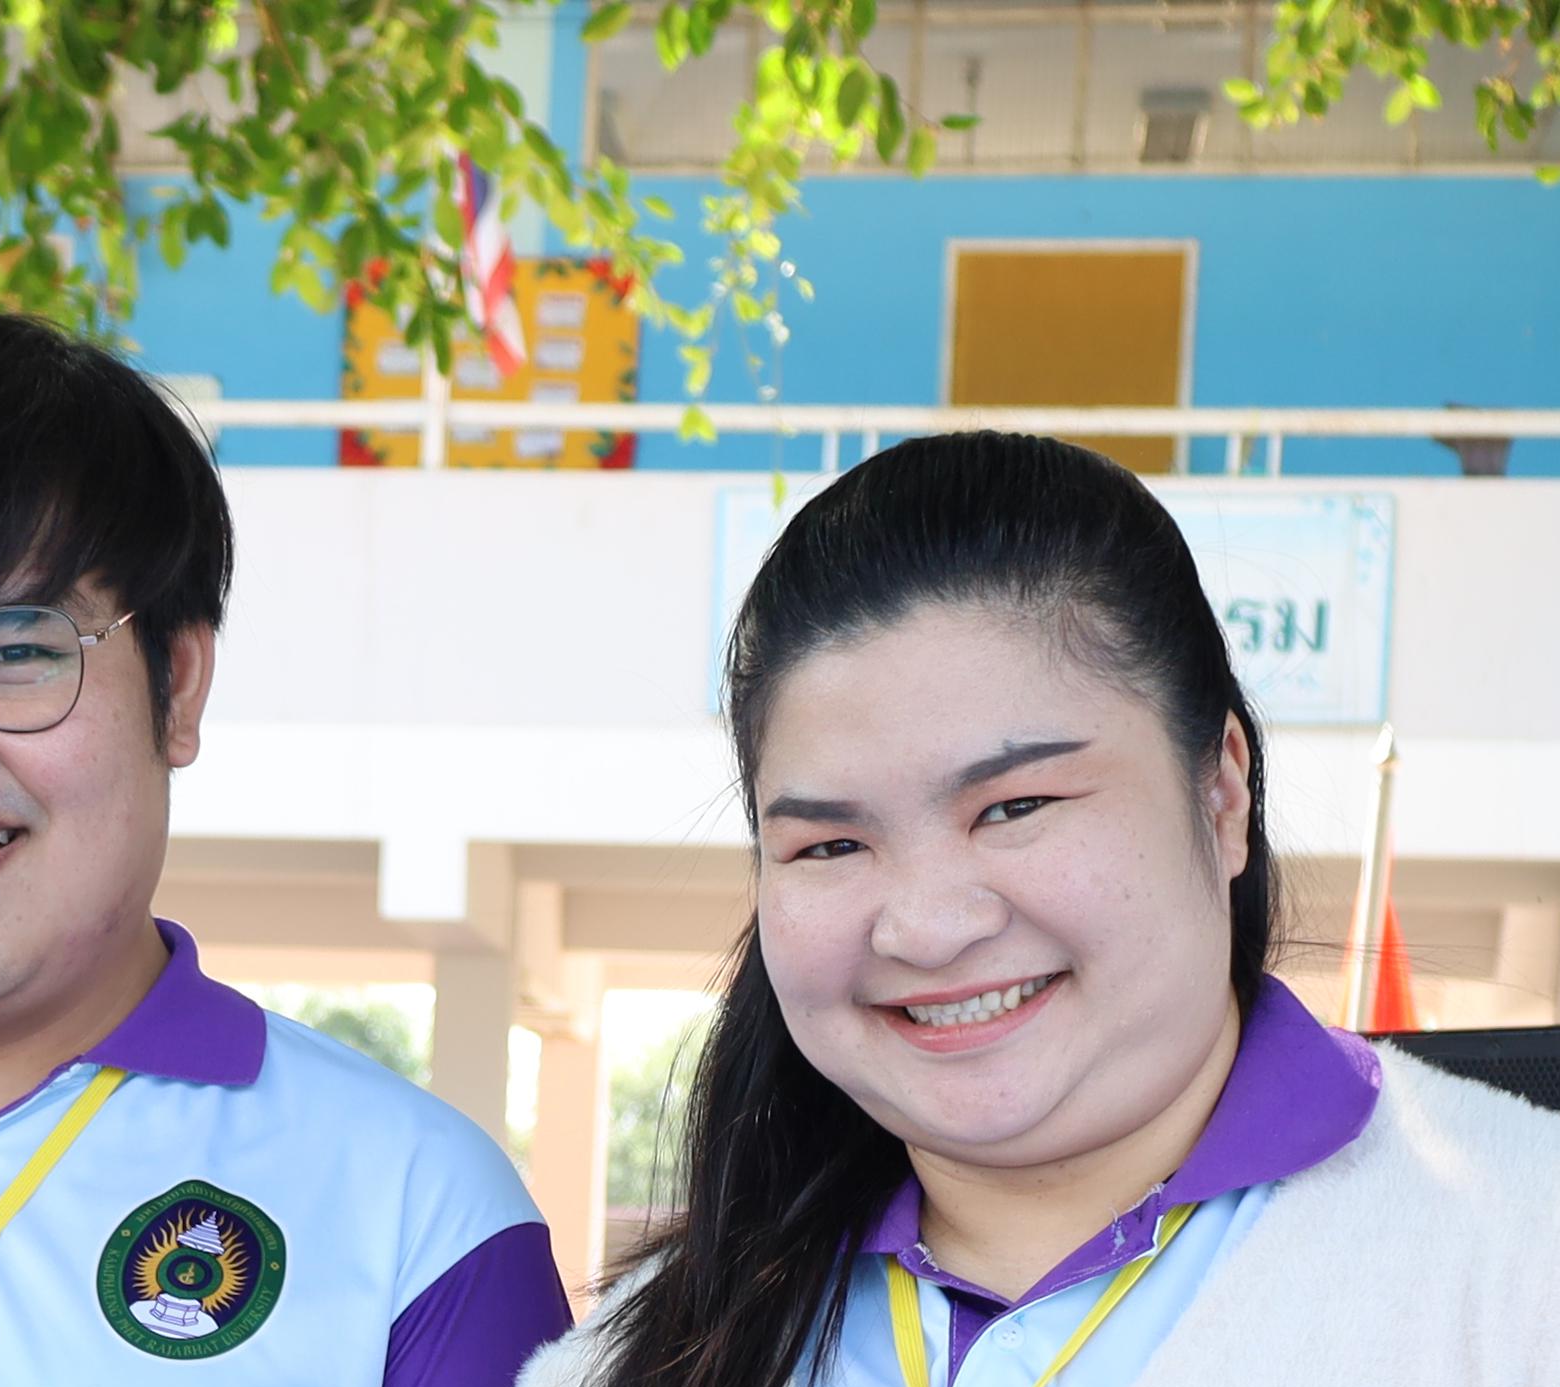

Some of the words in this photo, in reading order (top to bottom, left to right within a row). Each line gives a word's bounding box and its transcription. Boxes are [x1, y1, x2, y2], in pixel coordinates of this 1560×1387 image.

[1225, 597, 1330, 652] รม
[119, 1318, 145, 1343] PHET
[146, 1339, 219, 1357] RAJABHAT
[221, 1286, 275, 1346] UNIVERSITY
